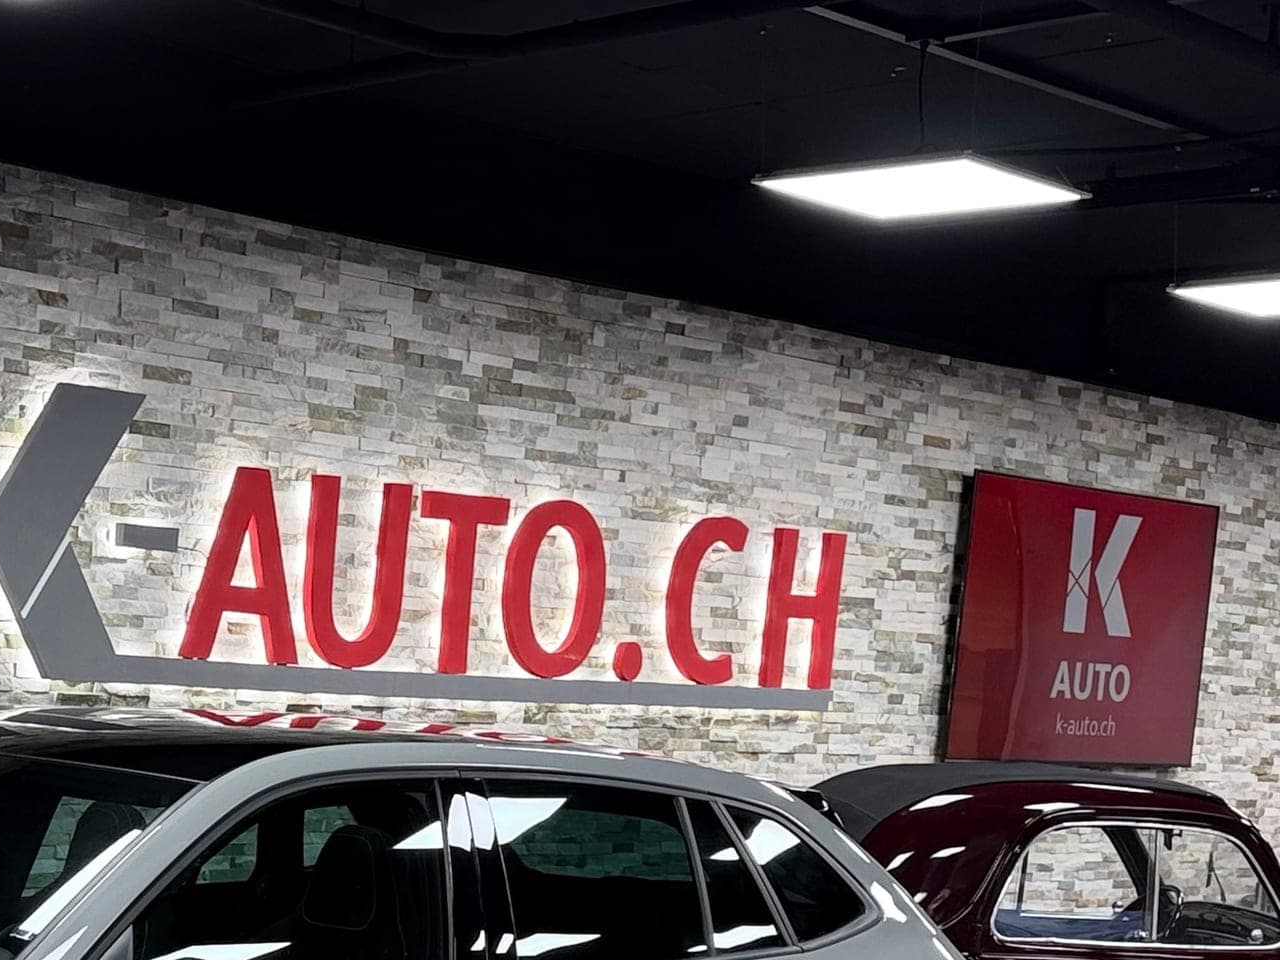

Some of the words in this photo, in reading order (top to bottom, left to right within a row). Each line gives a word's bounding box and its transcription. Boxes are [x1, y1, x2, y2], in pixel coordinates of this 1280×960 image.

[1063, 508, 1143, 637] K
[1050, 661, 1131, 702] AUTO
[1056, 712, 1115, 737] k-auto.ch
